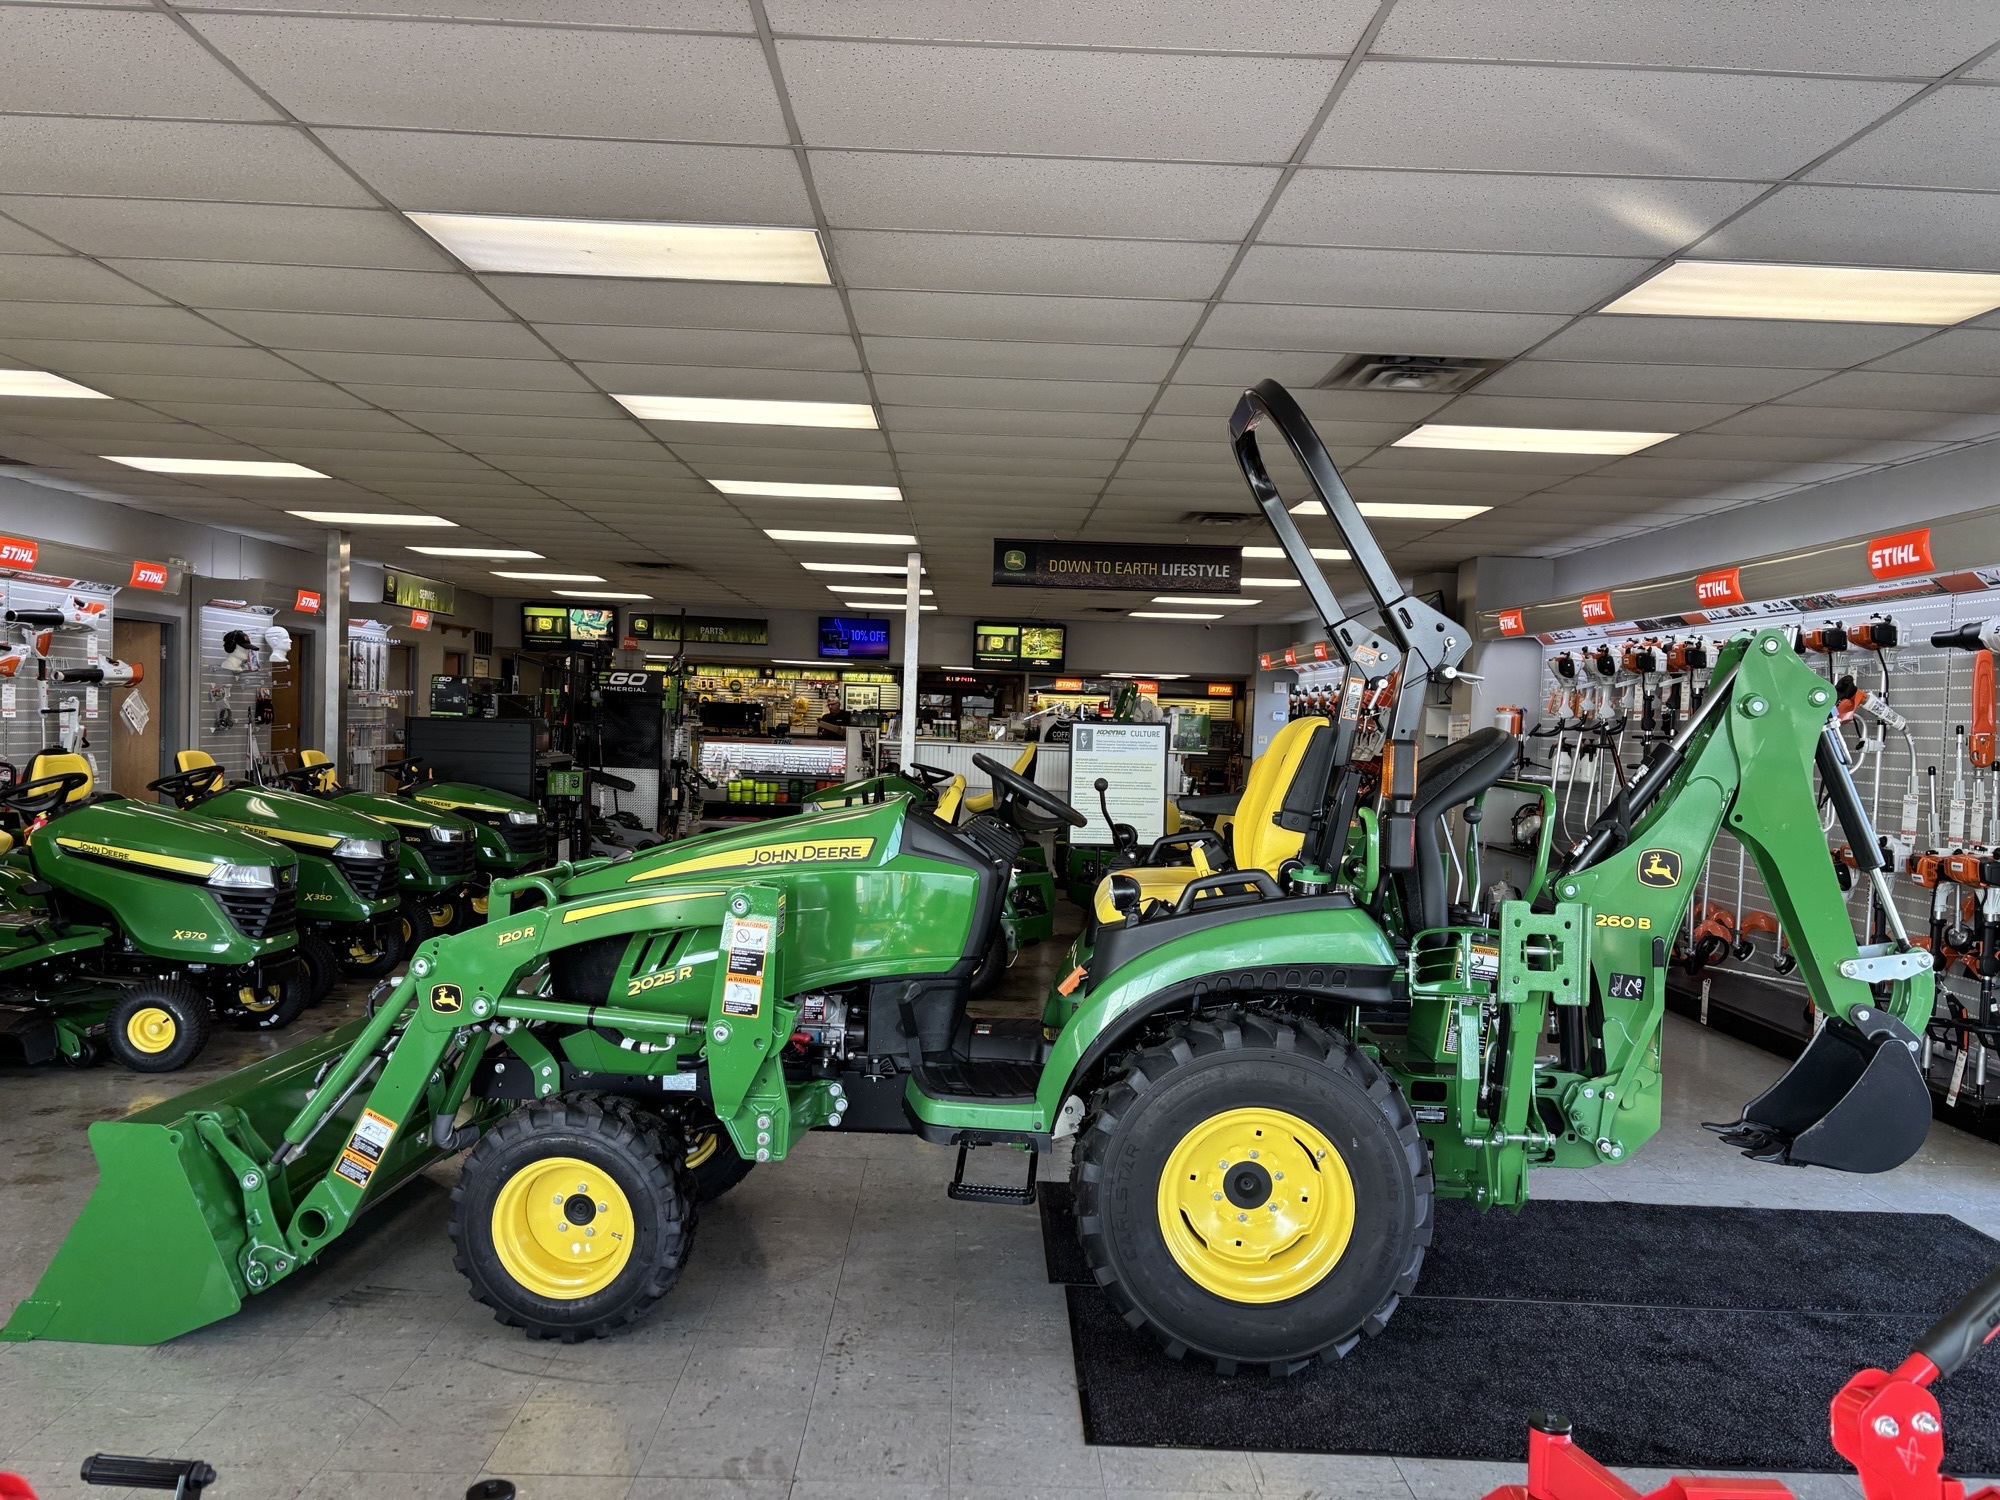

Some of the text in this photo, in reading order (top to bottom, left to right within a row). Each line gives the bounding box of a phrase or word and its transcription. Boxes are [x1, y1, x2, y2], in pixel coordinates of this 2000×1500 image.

[0, 546, 34, 563] STIHL
[1871, 543, 1920, 569] STIHL
[1050, 559, 1230, 578] DOWN TO EARTH LIFESTYLE
[137, 570, 165, 584] STIHL
[419, 588, 436, 602] SERVICE
[1698, 579, 1731, 599] STIHL
[300, 596, 319, 608] STIHL
[1582, 603, 1606, 617] STIHL
[415, 615, 428, 624] STIHL
[1499, 616, 1518, 630] STIHL
[700, 625, 724, 636] PARTS
[851, 629, 887, 642] 10% OFF
[598, 672, 649, 686] EGO
[1056, 681, 1081, 689] STIHL
[599, 685, 647, 693] MMERCIAL
[1209, 685, 1232, 693] STIHL
[1130, 730, 1160, 738] CULTURE
[244, 825, 269, 836] DEERE
[78, 841, 130, 861] JOHN DEERE
[747, 845, 862, 865] JOHN DEERE
[304, 892, 333, 903] X350
[740, 920, 769, 930] WARNING
[1594, 913, 1652, 931] 260 B
[172, 929, 208, 940] X370
[498, 926, 536, 947] 120 R
[1474, 946, 1498, 957] ARNING
[627, 966, 693, 997] 2025 R
[732, 976, 761, 986] WARNING
[372, 1114, 394, 1128] WARNING
[352, 1155, 372, 1169] WARNING
